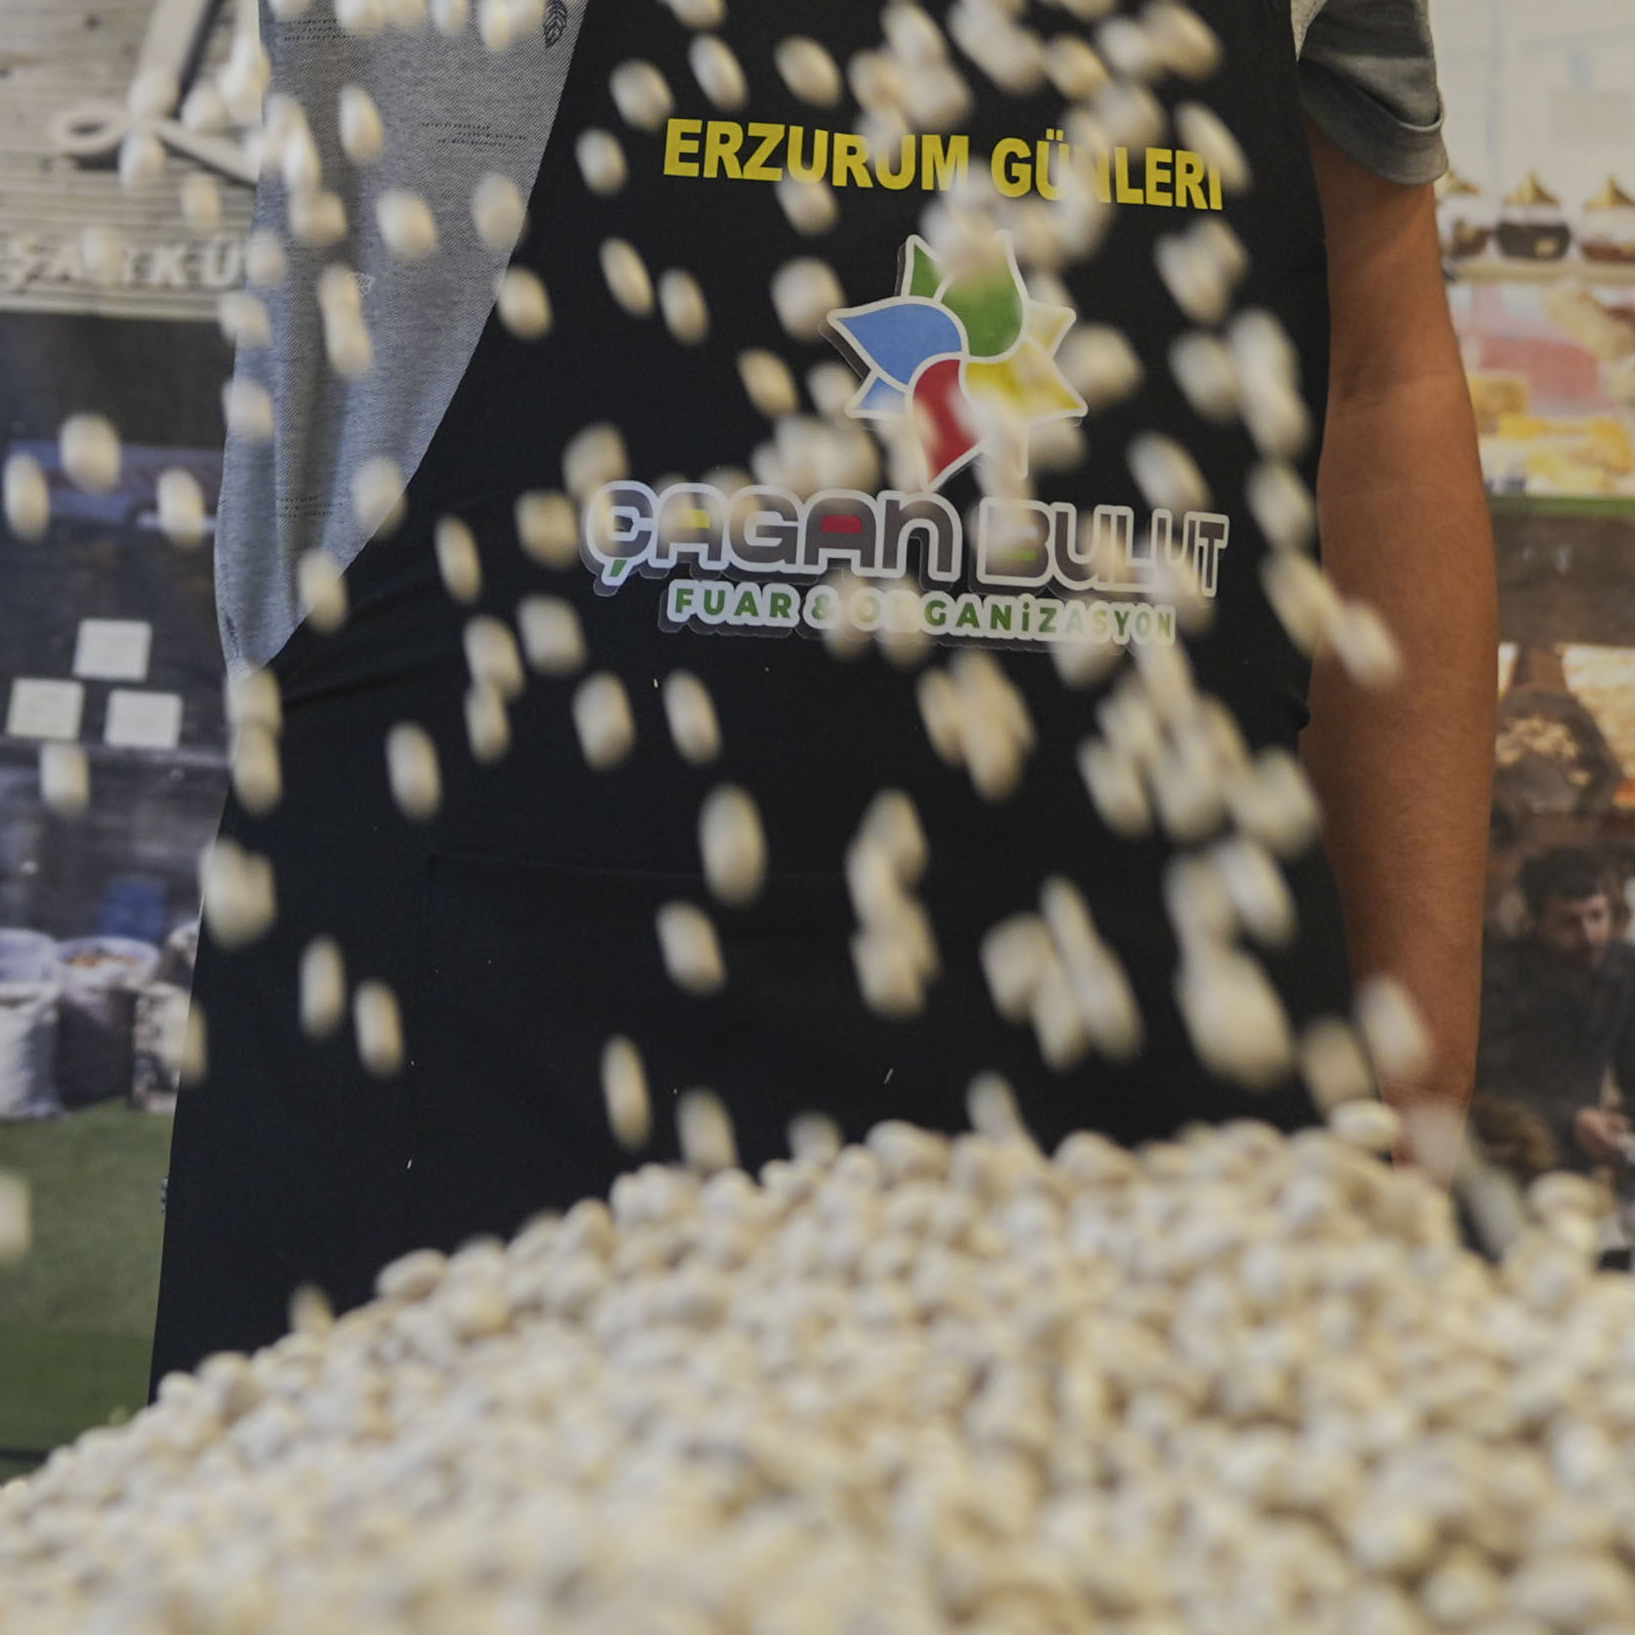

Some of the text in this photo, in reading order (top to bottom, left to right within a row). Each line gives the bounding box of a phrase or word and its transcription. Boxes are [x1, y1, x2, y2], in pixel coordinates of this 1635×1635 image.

[664, 117, 970, 192] ERZURUM
[675, 587, 793, 621] FUAR
[853, 595, 1173, 639] OGANİZASYON
